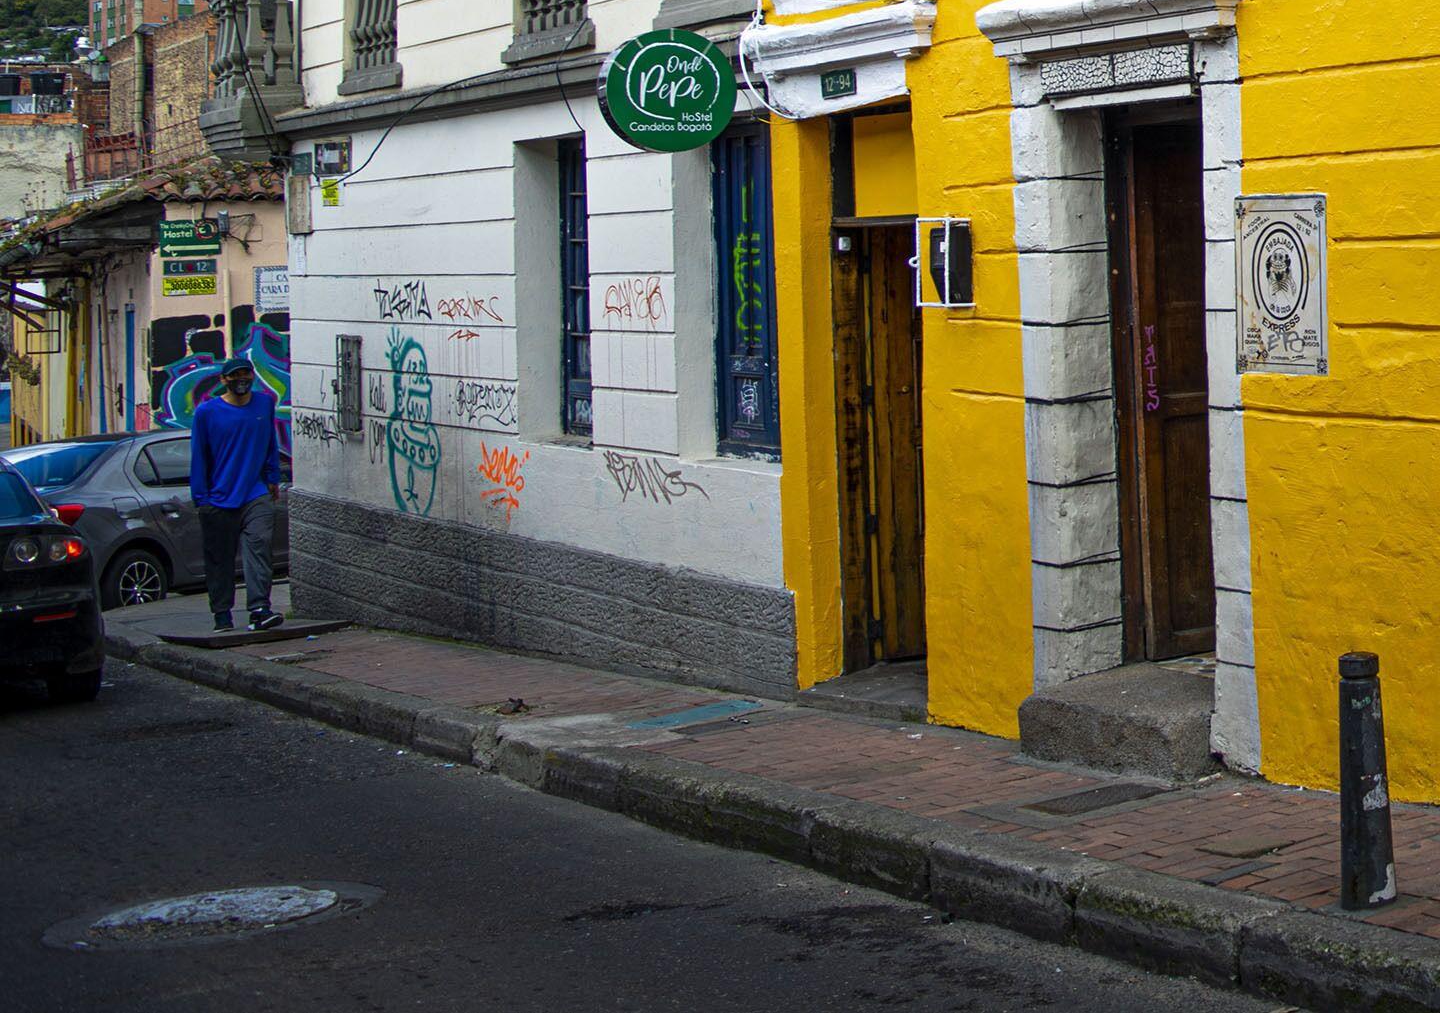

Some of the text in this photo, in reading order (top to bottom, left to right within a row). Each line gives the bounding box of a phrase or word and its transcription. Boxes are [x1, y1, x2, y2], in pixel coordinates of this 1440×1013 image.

[677, 122, 712, 132] Bogotá
[163, 229, 193, 238] Hostel
[1265, 236, 1295, 253] EMBAJADA
[1262, 313, 1301, 333] EXPRESS
